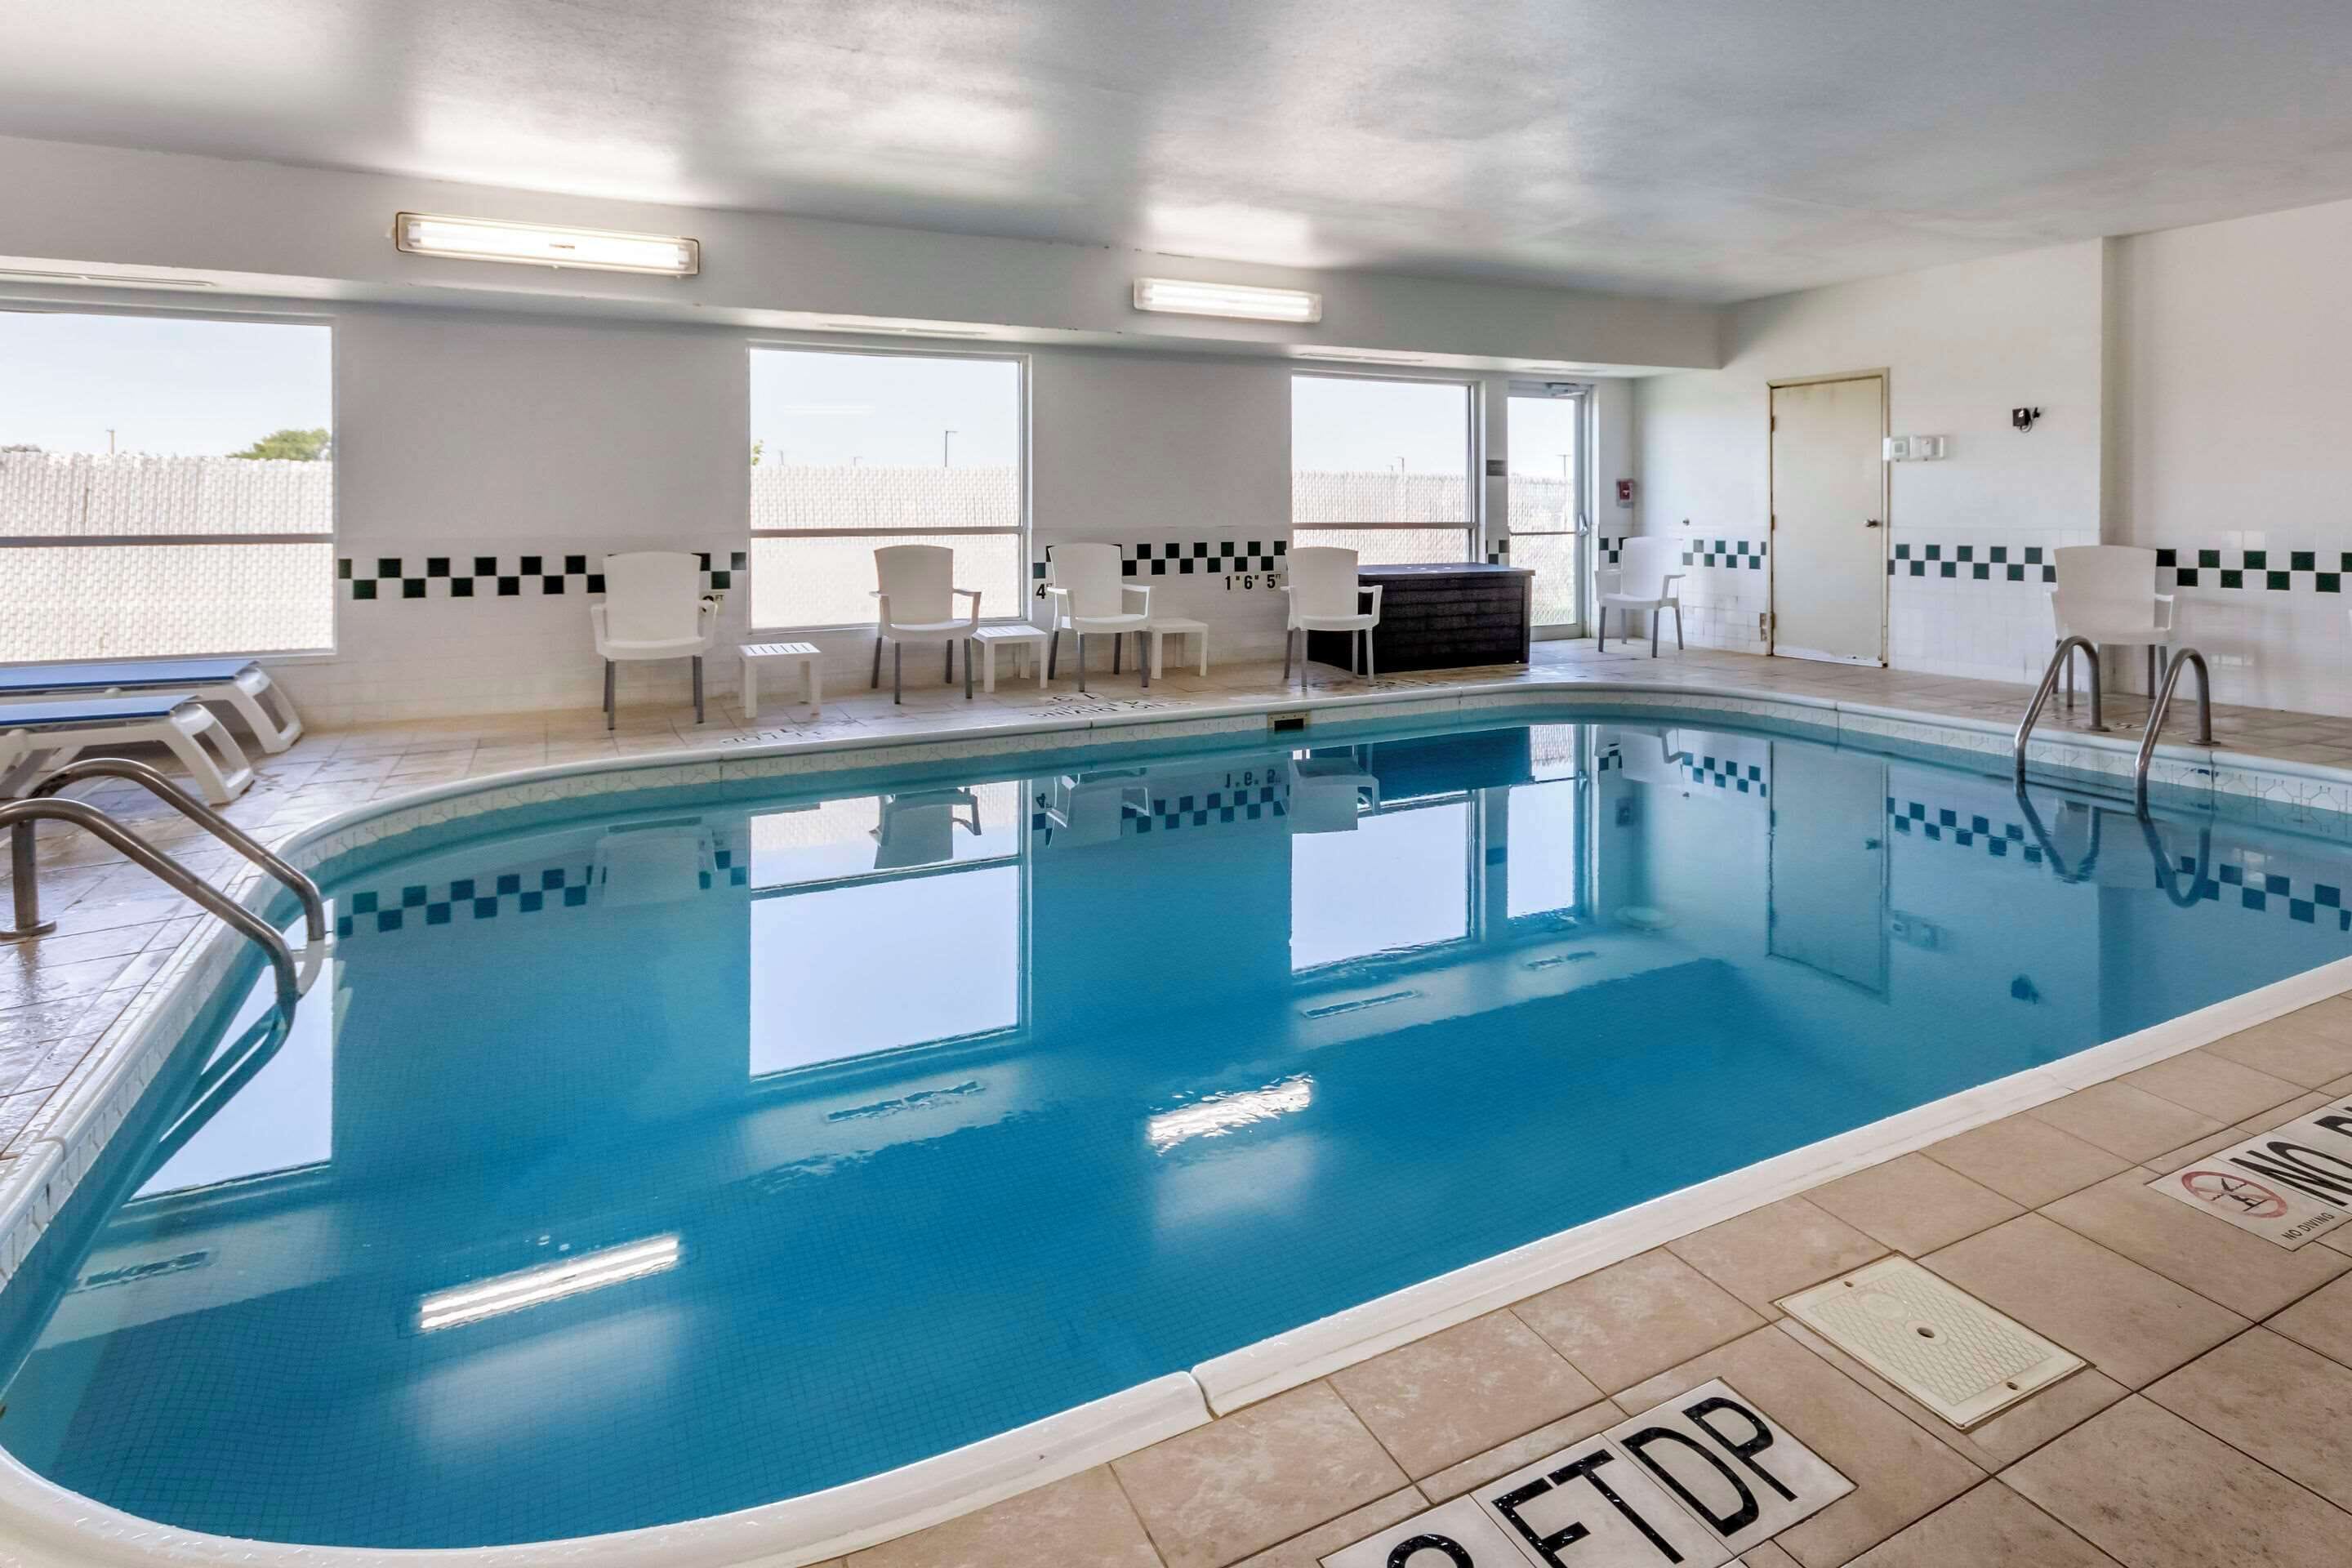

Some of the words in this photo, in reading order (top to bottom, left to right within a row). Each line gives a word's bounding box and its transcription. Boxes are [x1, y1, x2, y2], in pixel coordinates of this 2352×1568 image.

[2230, 1141, 2352, 1207] NO
[2281, 1229, 2303, 1241] NO
[2297, 1212, 2336, 1232] DIVING
